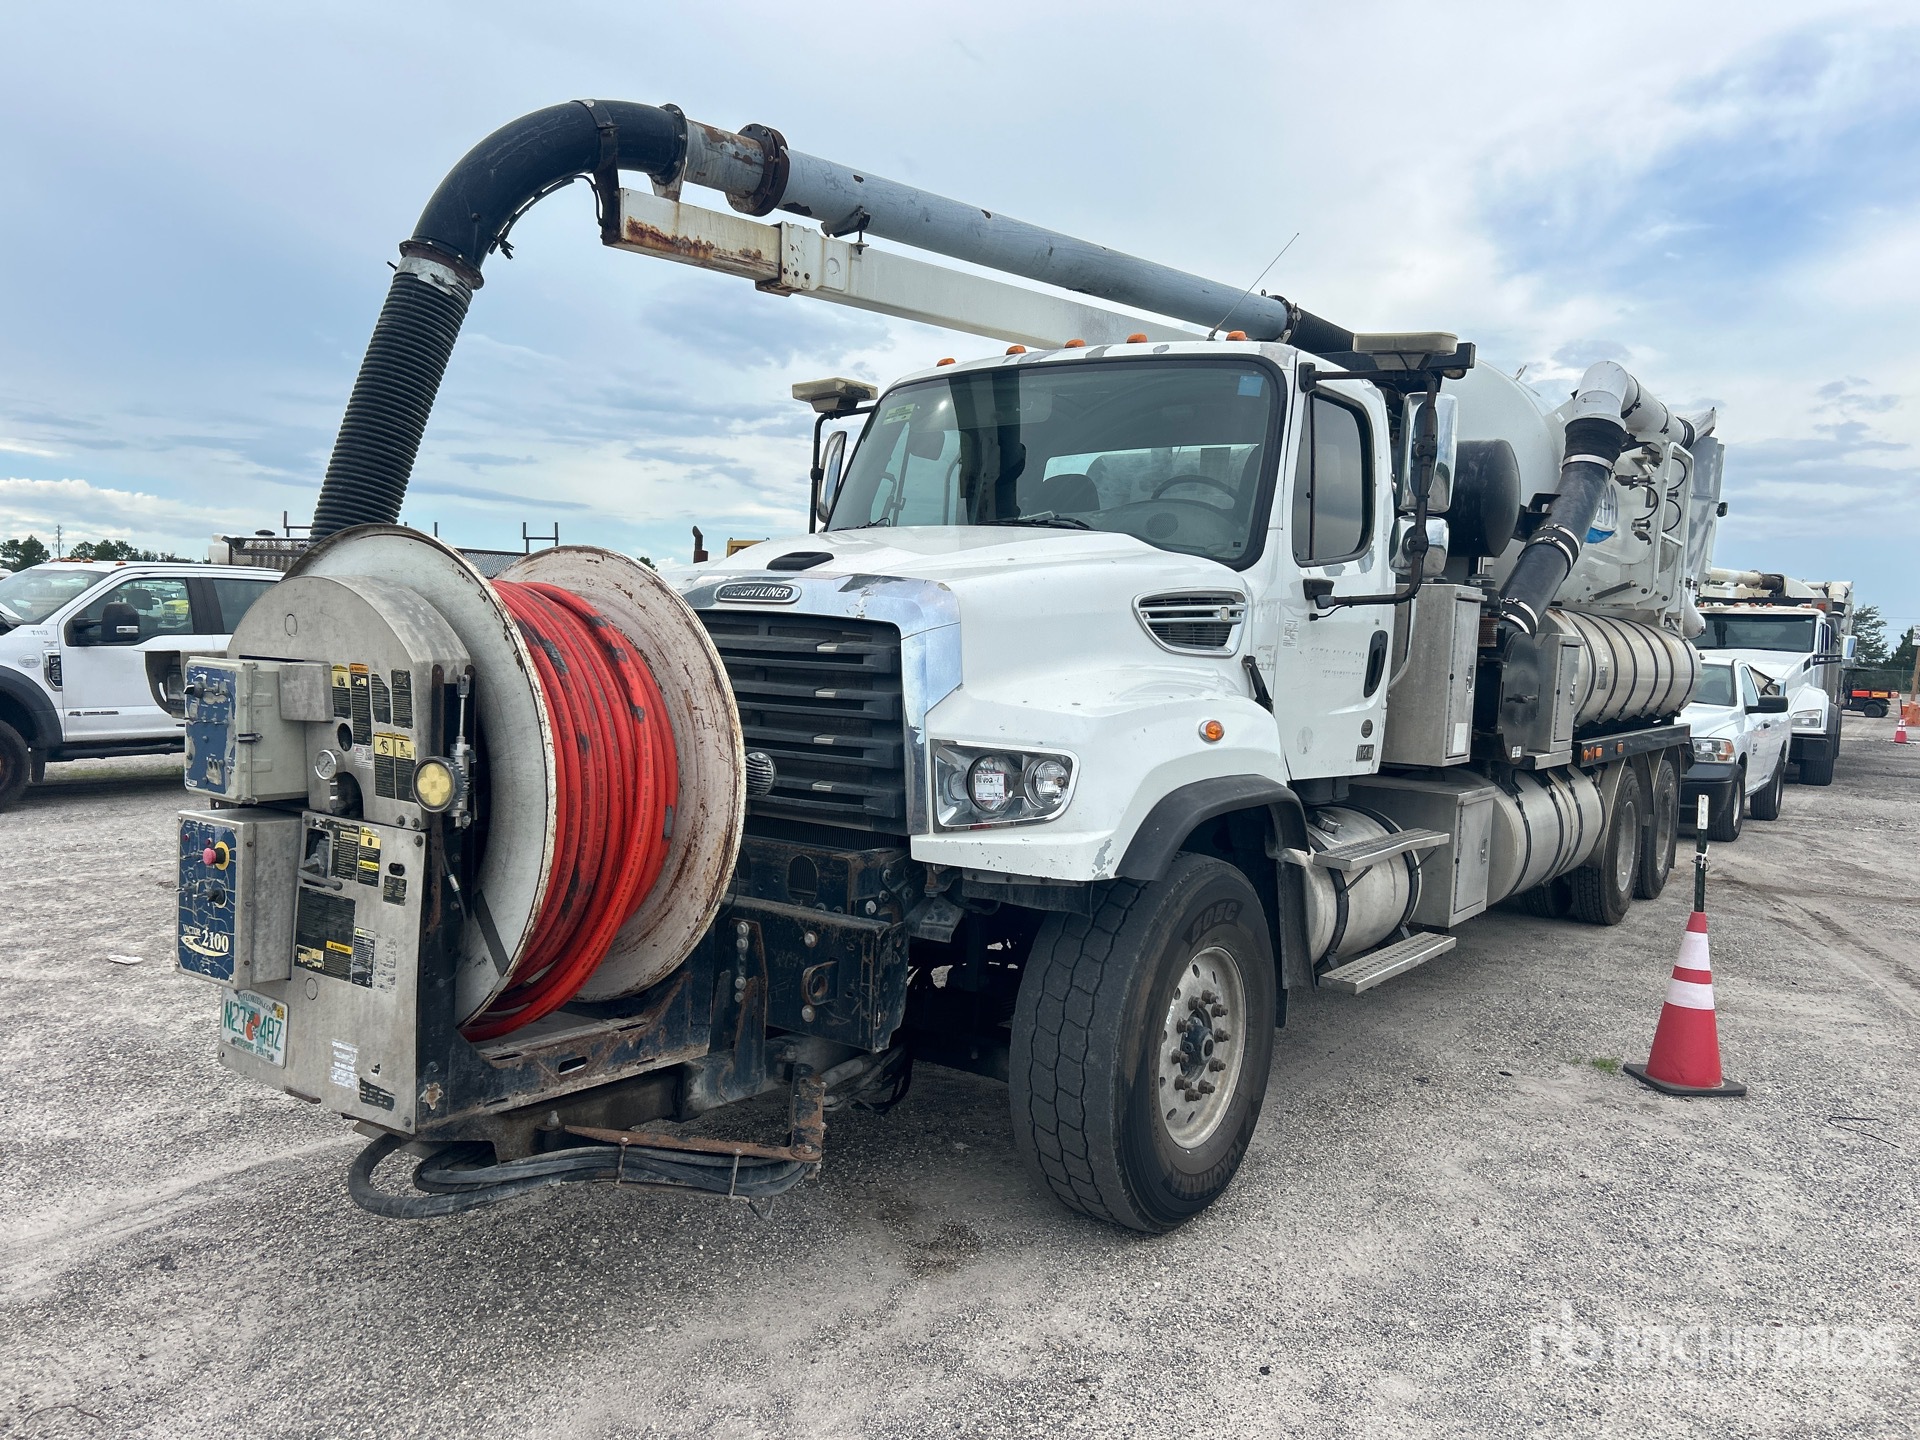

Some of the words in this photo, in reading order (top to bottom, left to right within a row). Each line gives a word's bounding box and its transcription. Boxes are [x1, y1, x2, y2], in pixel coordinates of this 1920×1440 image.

[721, 586, 791, 598] FREIGHTLINER
[201, 929, 229, 952] 2100
[223, 1001, 246, 1035] N23
